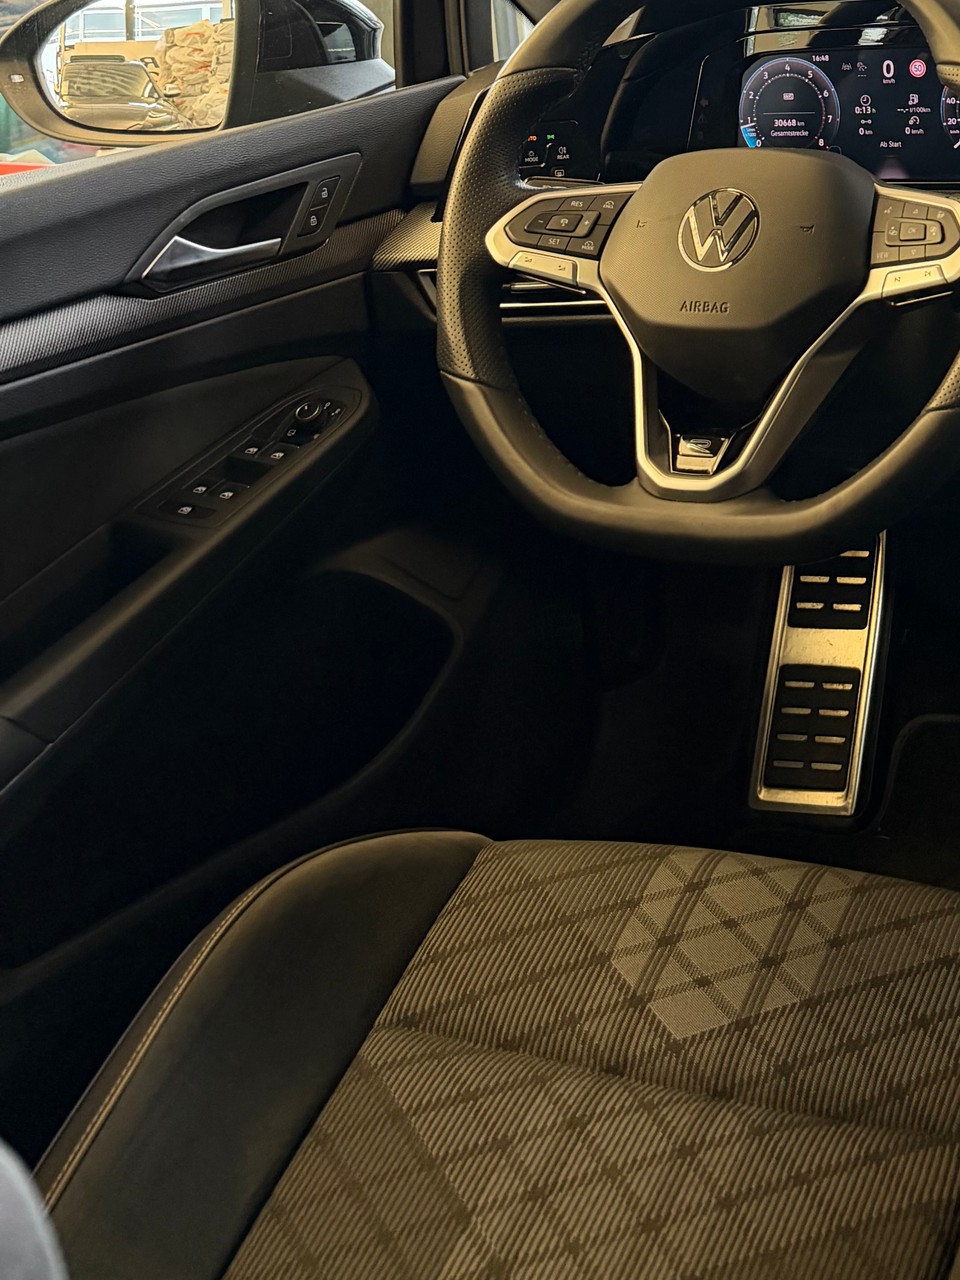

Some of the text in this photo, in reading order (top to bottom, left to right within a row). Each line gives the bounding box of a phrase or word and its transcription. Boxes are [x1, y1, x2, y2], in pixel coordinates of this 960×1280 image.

[784, 63, 791, 71] 4
[882, 60, 895, 78] 0
[913, 64, 923, 72] 50
[763, 72, 769, 80] 3
[748, 91, 754, 99] 2
[854, 106, 872, 114] 0:13
[774, 119, 797, 127] 30668
[827, 115, 833, 123] 7
[770, 129, 809, 137] Gesamtstrecke
[859, 127, 864, 135] 0
[756, 140, 762, 148] 0
[818, 138, 824, 147] 8
[680, 300, 730, 314] AIRBAG
